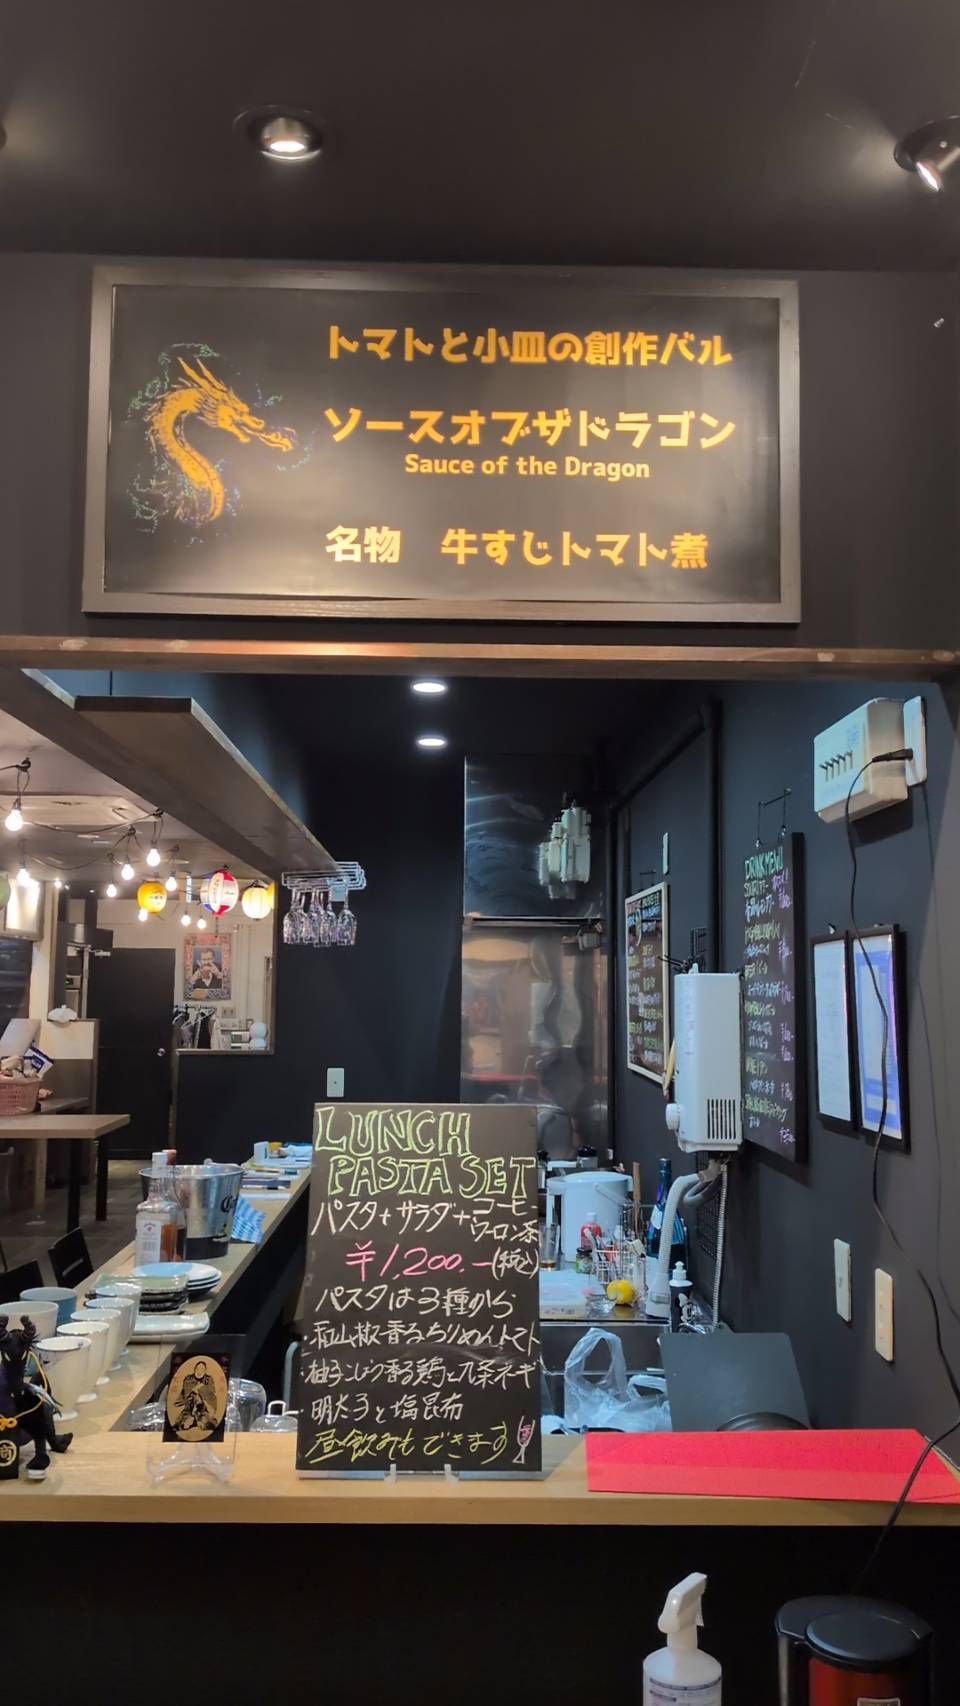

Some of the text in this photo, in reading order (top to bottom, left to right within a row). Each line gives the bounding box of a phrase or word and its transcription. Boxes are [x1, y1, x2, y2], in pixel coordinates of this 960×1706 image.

[329, 326, 733, 367] トマトと小皿の創作バル
[324, 408, 736, 449] ソースオブザドラゴン
[404, 454, 651, 482] Sauce of the Dragon
[325, 526, 709, 570] 名物 牛すじトマト煮
[314, 1106, 472, 1157] LUNCH
[328, 1155, 537, 1199] PASTA SET
